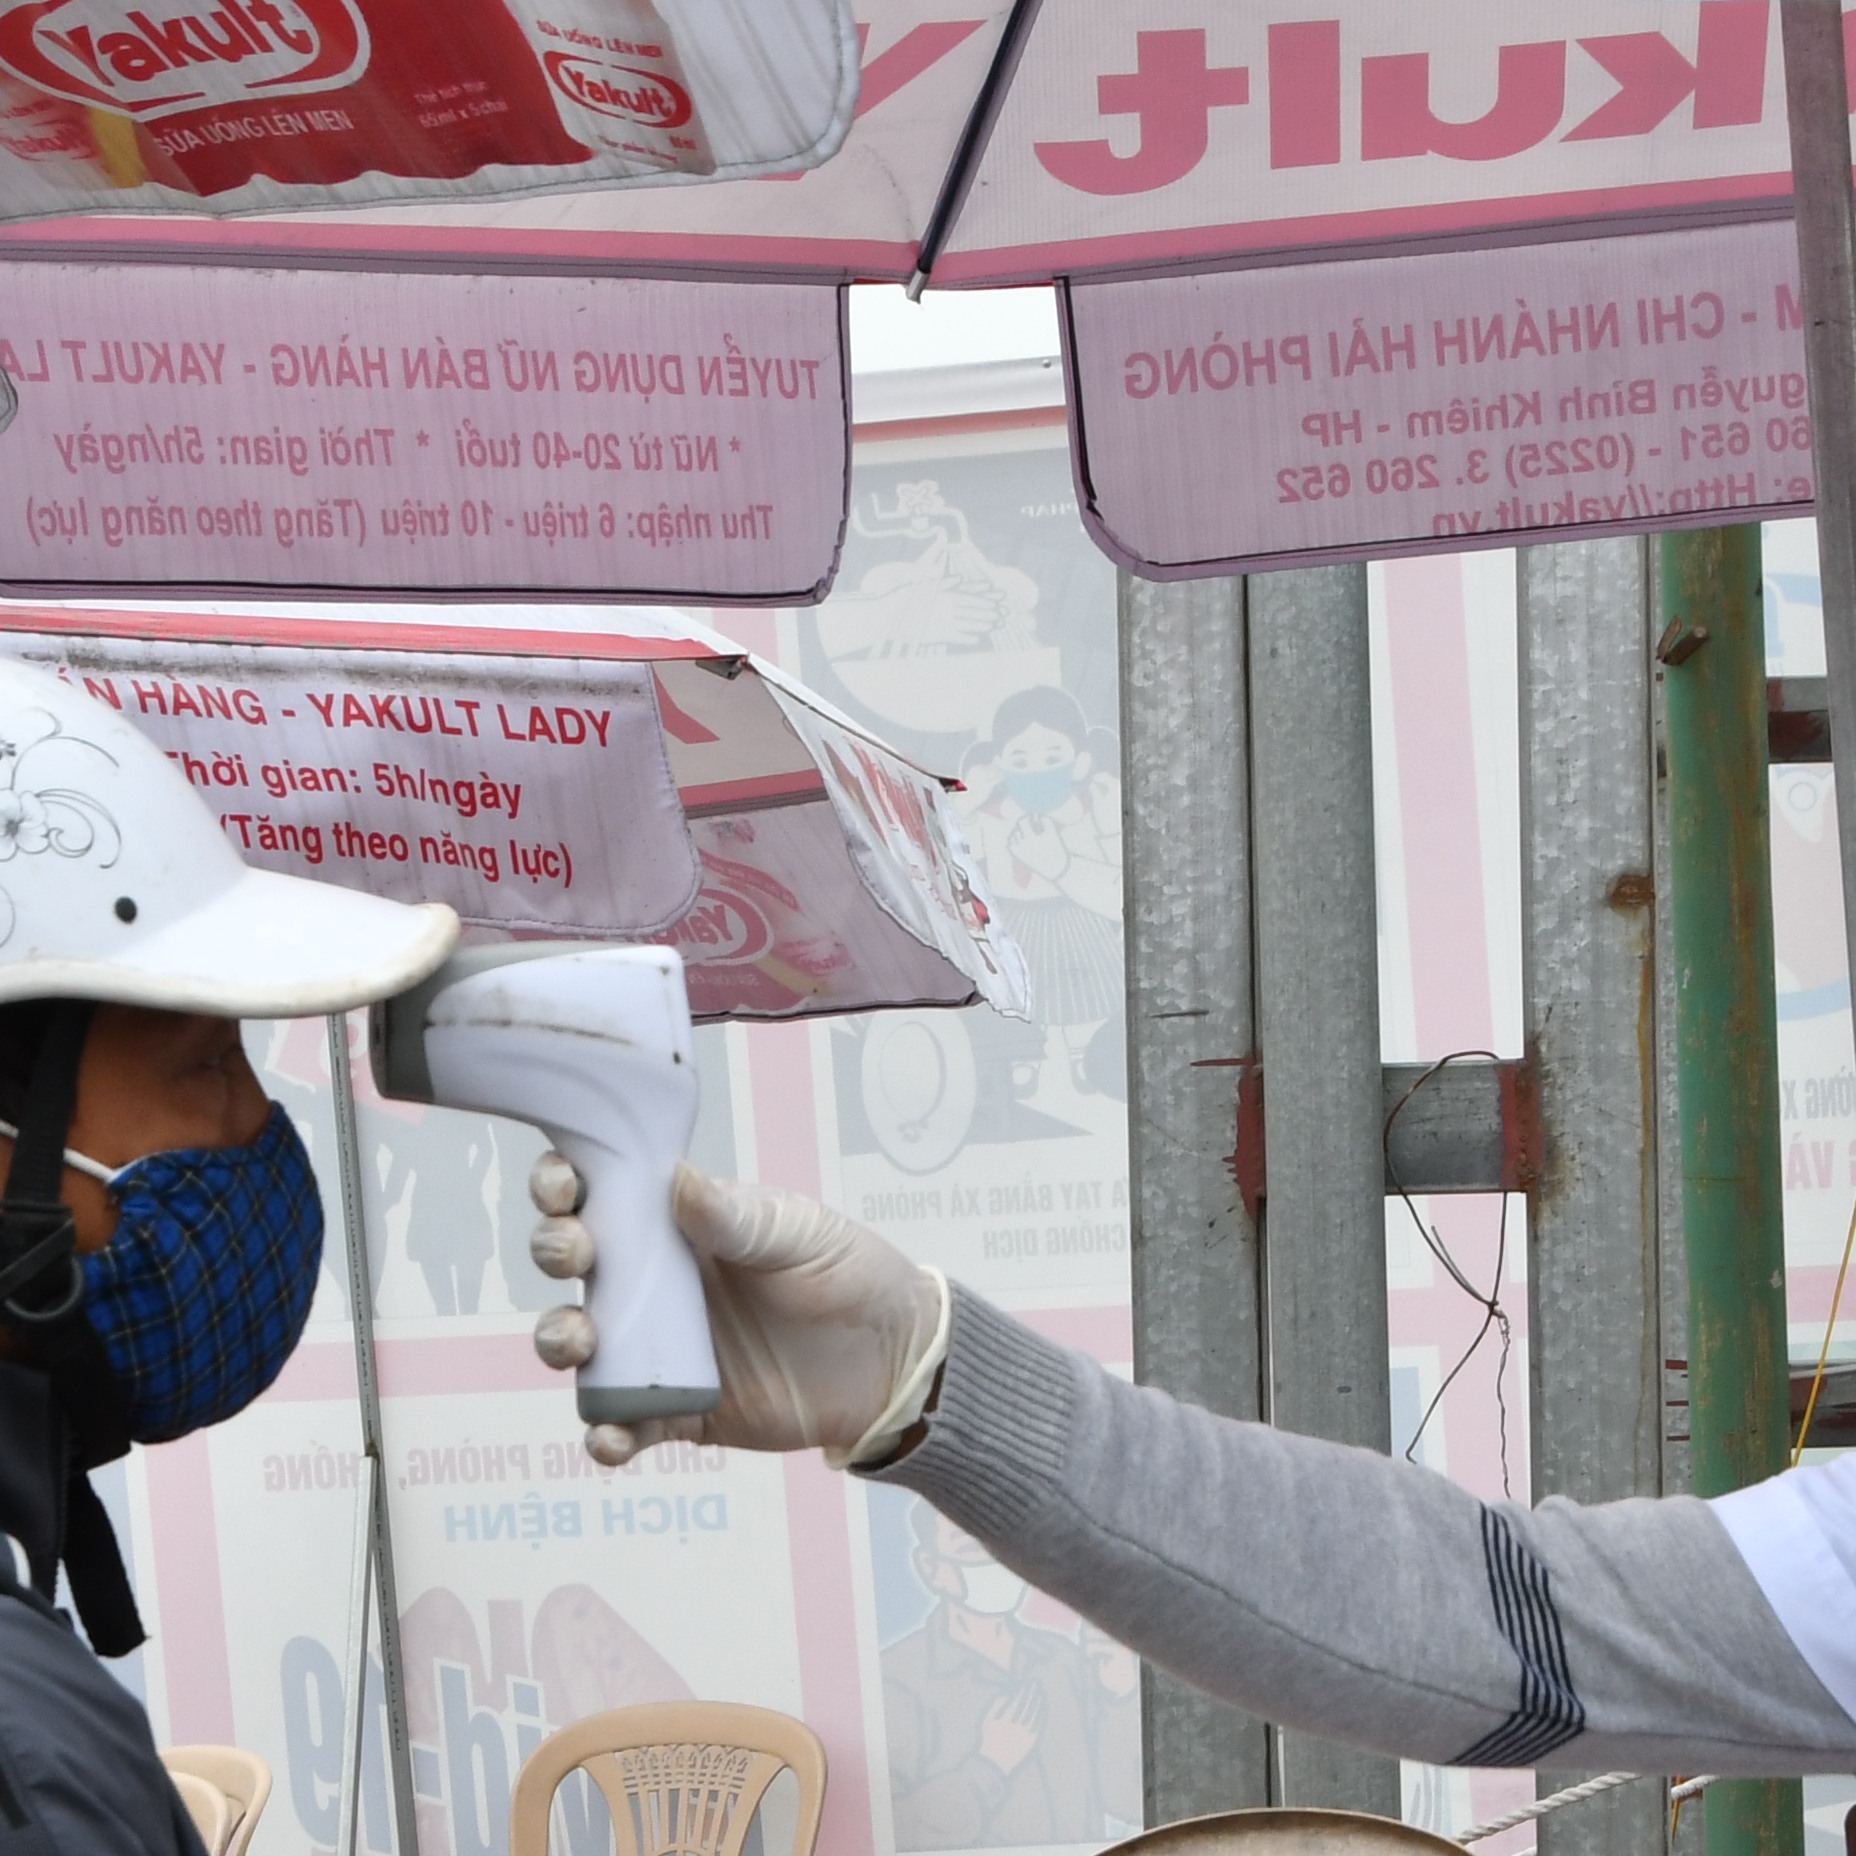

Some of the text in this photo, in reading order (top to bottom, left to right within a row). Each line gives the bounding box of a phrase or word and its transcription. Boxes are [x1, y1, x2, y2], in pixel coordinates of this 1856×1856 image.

[37, 0, 314, 88] Yakult
[561, 64, 673, 118] Yakult
[132, 674, 268, 727] HÀNG
[305, 691, 482, 738] YAKULT
[496, 703, 611, 748] LADY
[260, 758, 363, 799] gian:
[372, 761, 523, 821] 5h/ngày
[219, 813, 574, 891] (Tăng theo năng lực)
